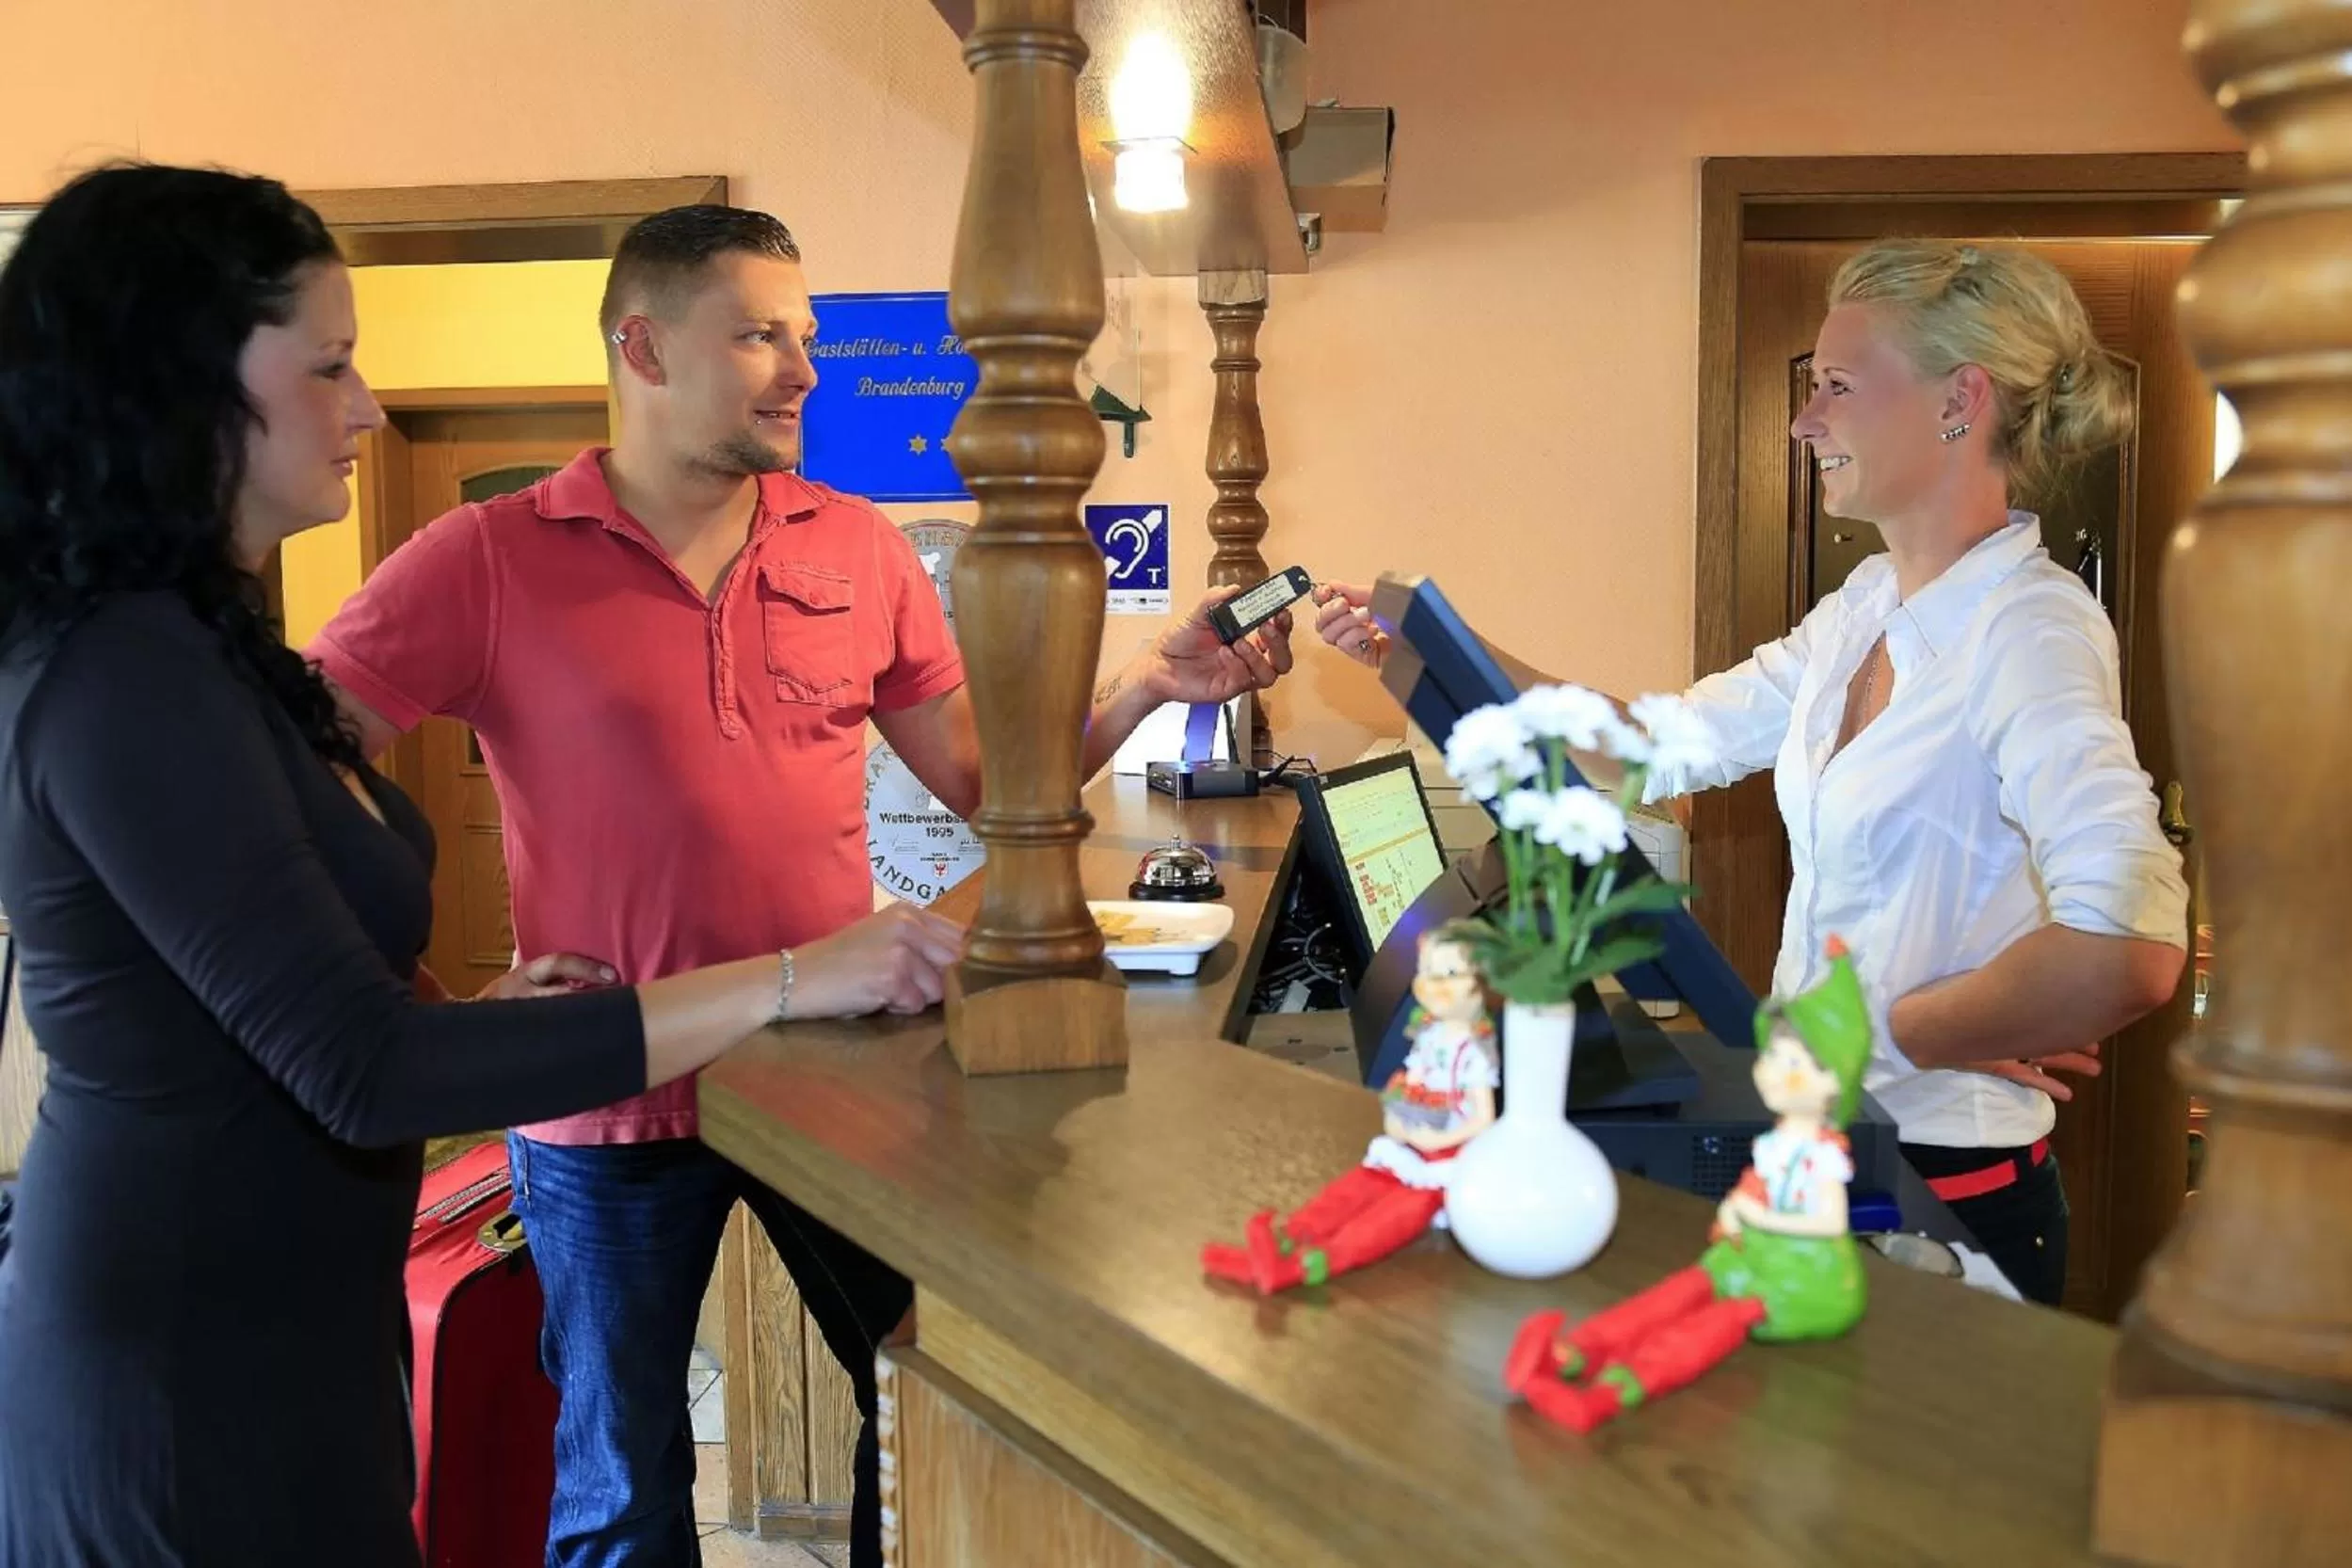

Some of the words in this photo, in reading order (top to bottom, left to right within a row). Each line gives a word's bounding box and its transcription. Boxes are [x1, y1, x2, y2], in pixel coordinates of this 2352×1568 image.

[913, 342, 926, 356] u.
[855, 376, 964, 400] Brandenburg
[1146, 568, 1161, 584] T
[879, 812, 966, 824] Wettbewerbs
[925, 826, 954, 838] 1995
